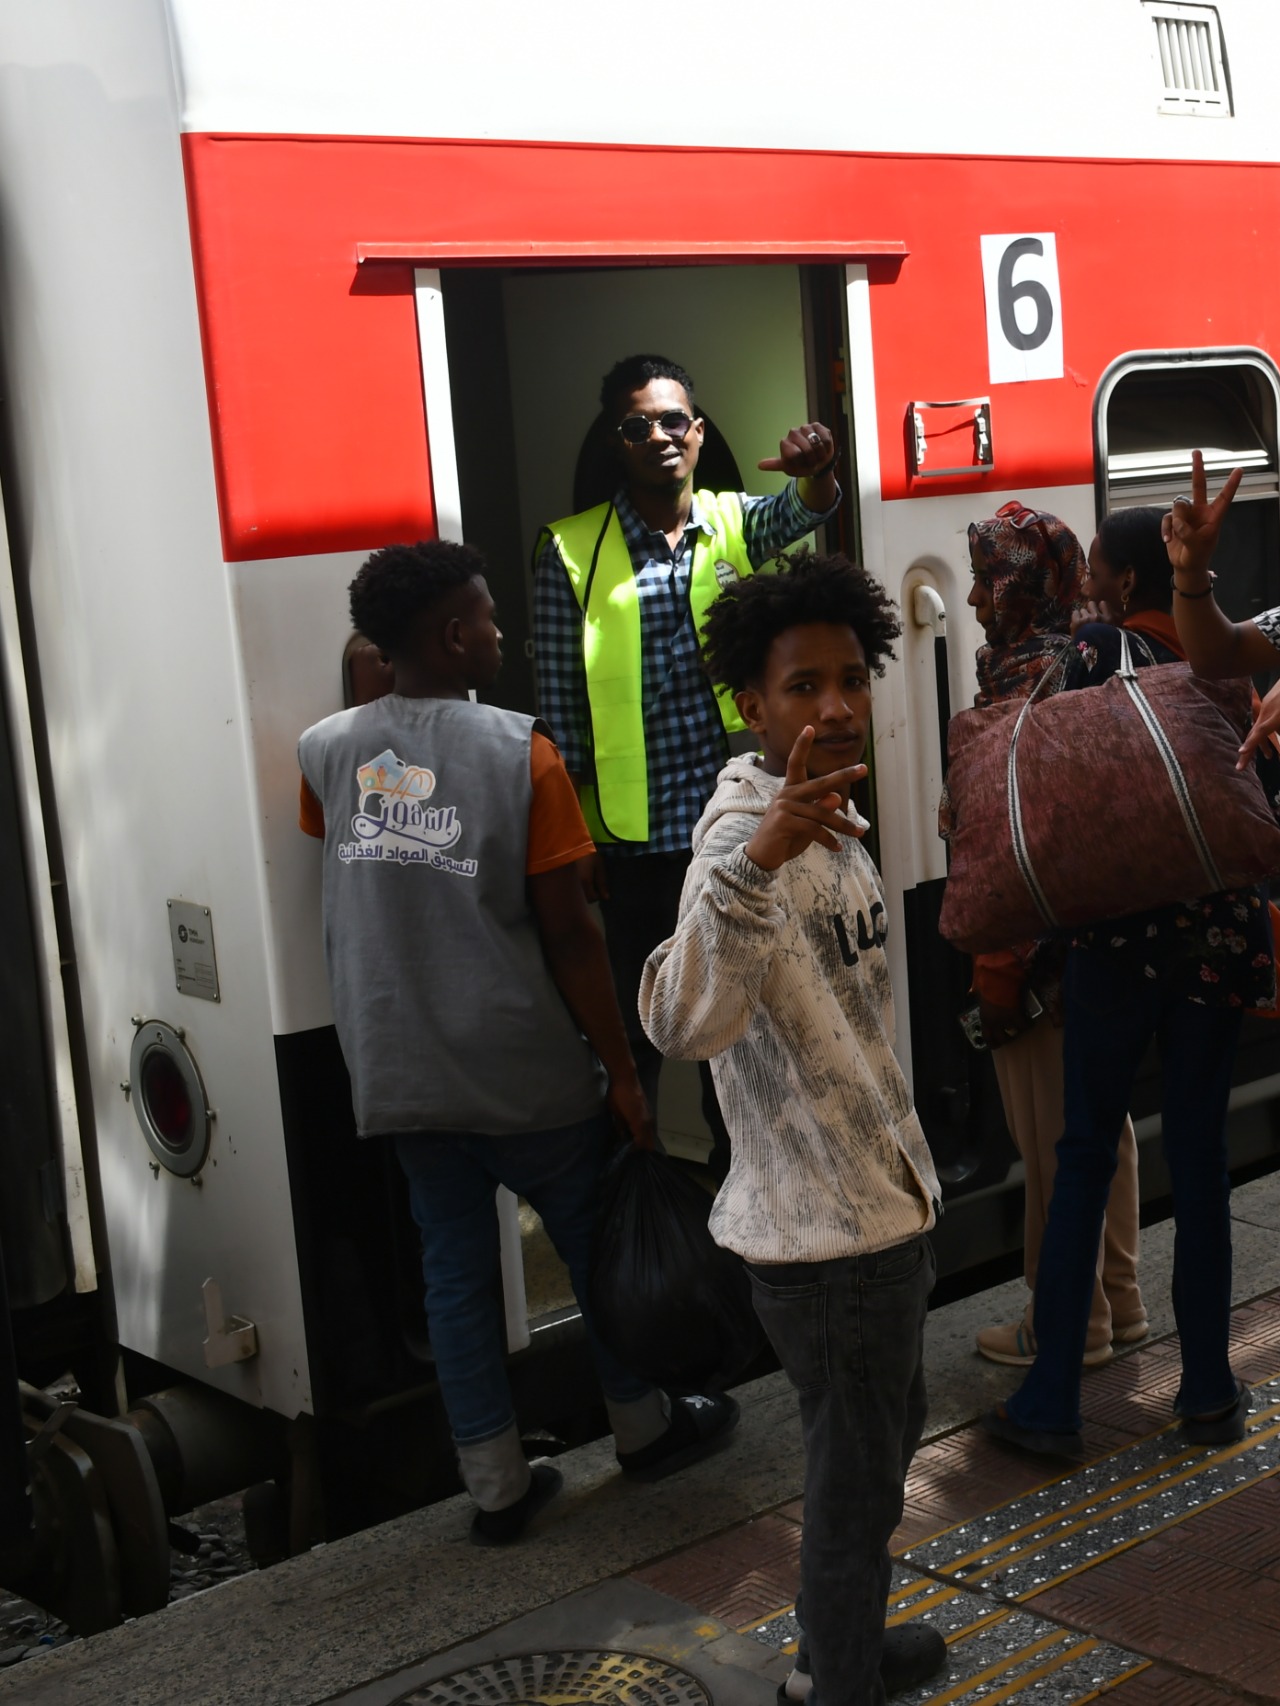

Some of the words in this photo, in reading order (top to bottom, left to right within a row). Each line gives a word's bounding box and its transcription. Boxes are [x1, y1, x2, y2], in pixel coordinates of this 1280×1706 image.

[998, 237, 1053, 351] 6
[339, 843, 384, 862] الغذائية
[386, 845, 428, 864] المواد
[431, 851, 477, 875] لتسويق
